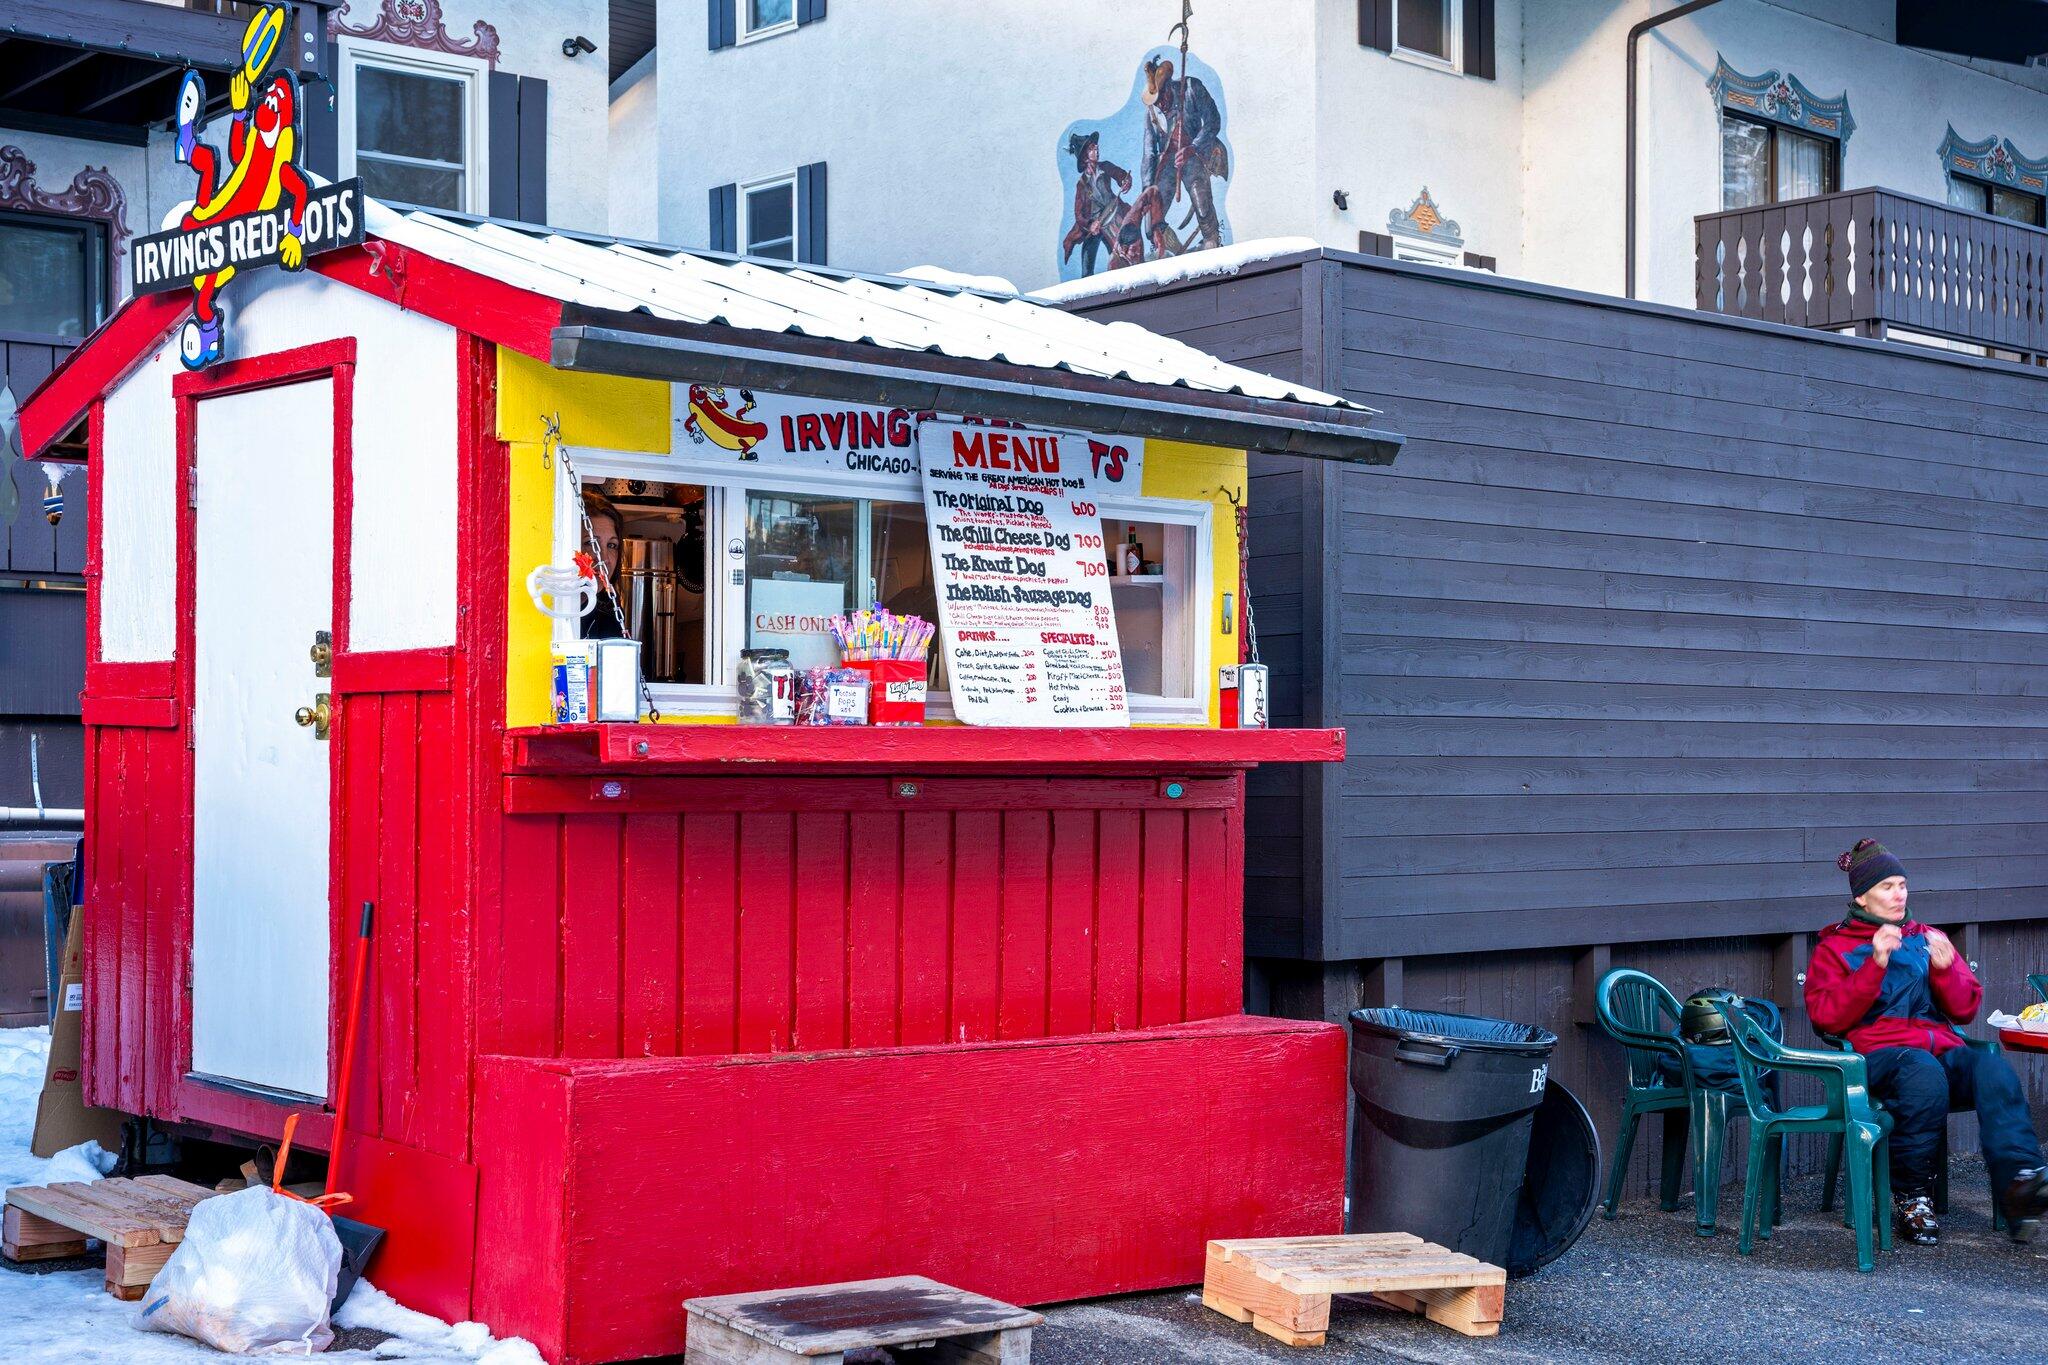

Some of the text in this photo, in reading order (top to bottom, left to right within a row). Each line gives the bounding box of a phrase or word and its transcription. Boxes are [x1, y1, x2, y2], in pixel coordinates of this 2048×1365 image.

[136, 226, 225, 284] IRVING'S
[846, 451, 923, 475] CHICAGO-
[952, 430, 1060, 473] MENU
[1088, 439, 1129, 483] TS
[965, 472, 978, 481] THE
[982, 473, 1006, 484] GREAT
[1008, 475, 1044, 487] AMERICAN
[1045, 477, 1059, 488] HOT
[933, 490, 958, 508] The
[959, 492, 1015, 513] Original
[1016, 496, 1044, 516] Dog
[937, 524, 963, 542] The
[994, 527, 1042, 546] Cheese
[1044, 531, 1071, 552] Dog
[942, 553, 970, 571] The
[970, 554, 1014, 574] Kraut
[1016, 556, 1046, 577] Dog
[946, 584, 971, 602] The
[1067, 590, 1092, 608] Dog
[756, 614, 796, 631] CASH
